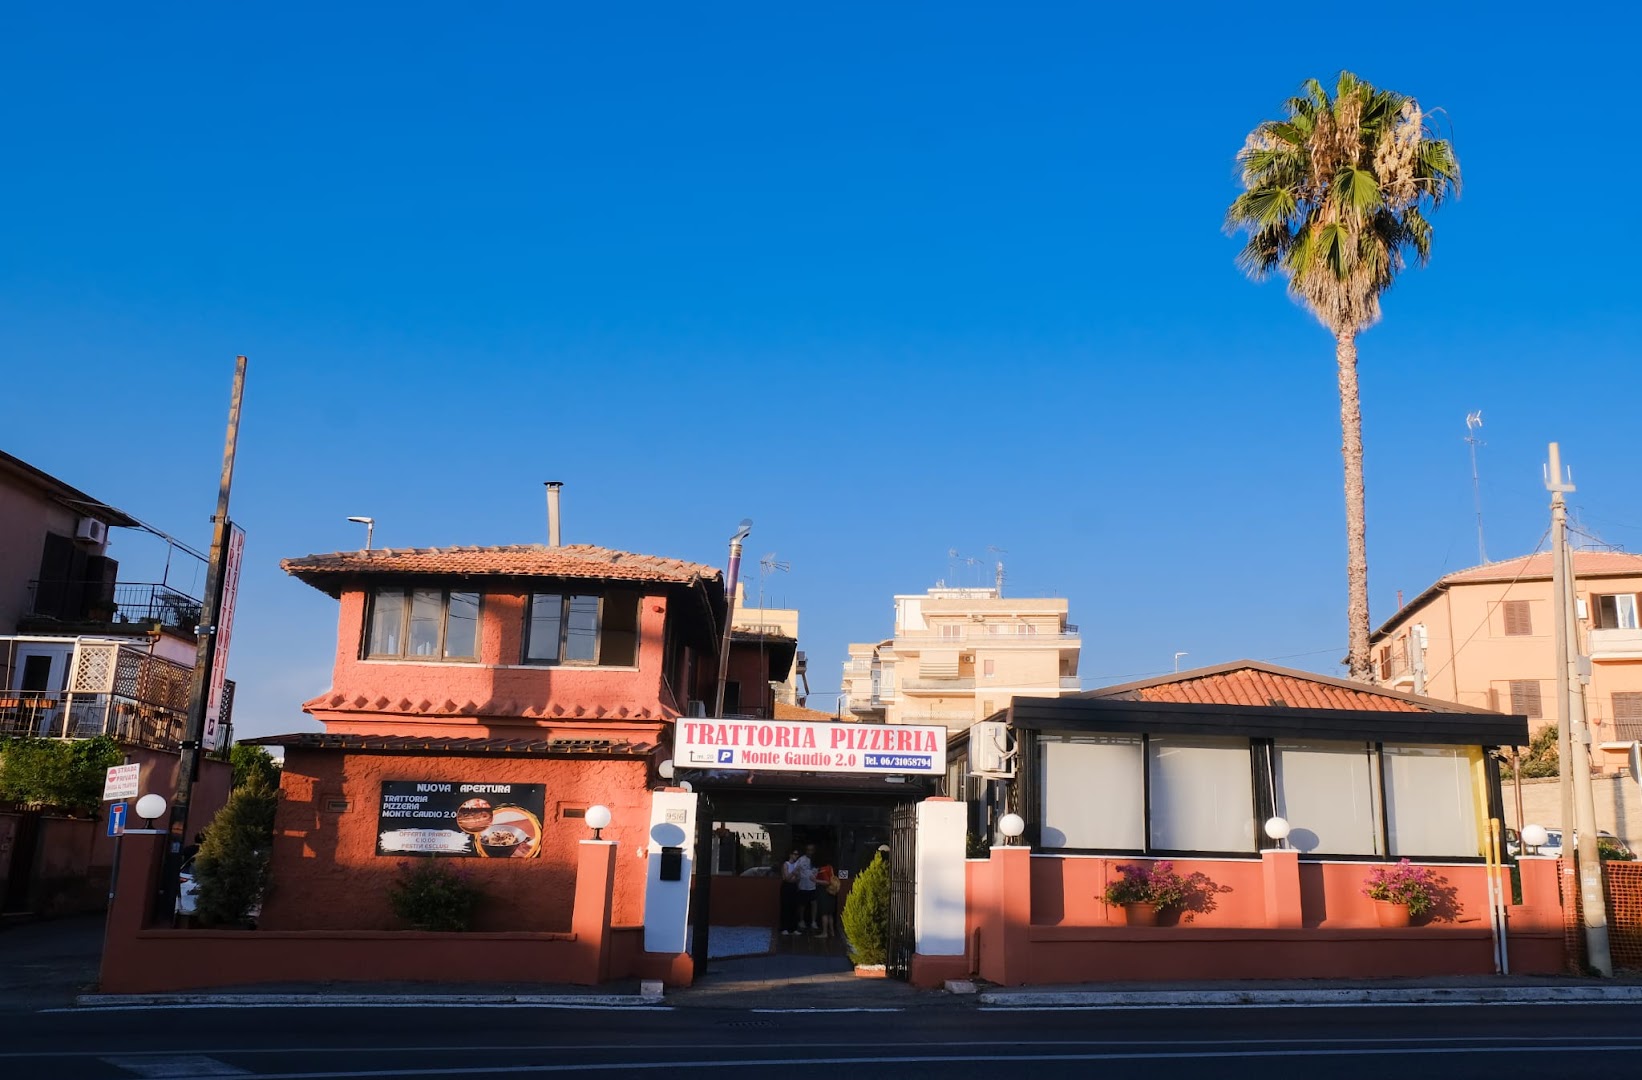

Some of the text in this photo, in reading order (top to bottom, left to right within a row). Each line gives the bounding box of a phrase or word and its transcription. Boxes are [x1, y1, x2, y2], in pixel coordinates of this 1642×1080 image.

[217, 533, 244, 690] PIZZERIA
[209, 529, 237, 709] TRATTORIA
[684, 723, 938, 752] TRATTORIA PIZZERIA
[720, 751, 731, 761] P
[741, 750, 780, 764] Monte
[784, 752, 831, 766] Gaudio
[835, 753, 857, 767] 2.0
[865, 756, 879, 765] Tel.
[880, 757, 931, 767] 06/31058794
[117, 766, 137, 774] STRADA
[116, 774, 138, 783] PRIVATA
[416, 783, 511, 793] NUOVA APERTURA
[384, 795, 428, 803] TRATTORIA
[381, 810, 411, 818] MONTE
[443, 811, 457, 819] 2.0
